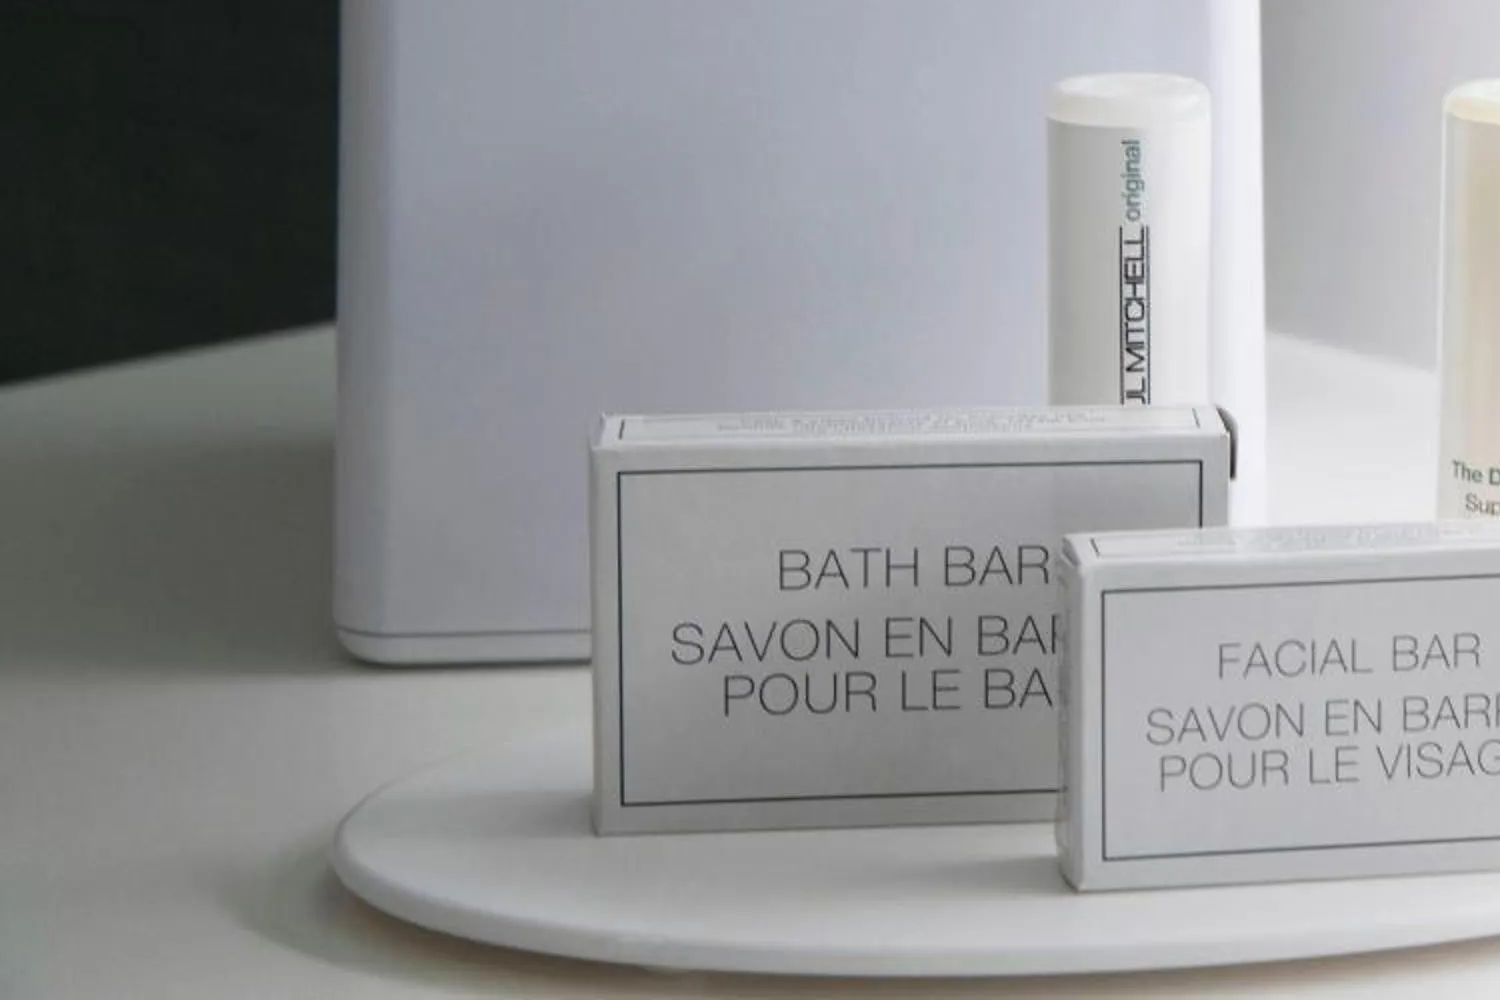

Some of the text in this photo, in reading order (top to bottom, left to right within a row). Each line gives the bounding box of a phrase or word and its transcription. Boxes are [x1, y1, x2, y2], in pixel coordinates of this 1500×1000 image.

[1120, 139, 1146, 222] original
[1124, 224, 1145, 373] MITCHELL
[1452, 459, 1484, 483] The
[778, 544, 1050, 592] BATH BAR
[670, 616, 861, 666] SAVON
[884, 615, 953, 659] EN
[1217, 632, 1482, 680] FACIAL BAR
[722, 666, 1055, 718] POUR LE BA
[1145, 702, 1305, 747] SAVON
[1323, 697, 1384, 737] EN
[1158, 749, 1291, 793] POUR
[1308, 745, 1360, 786] LE
